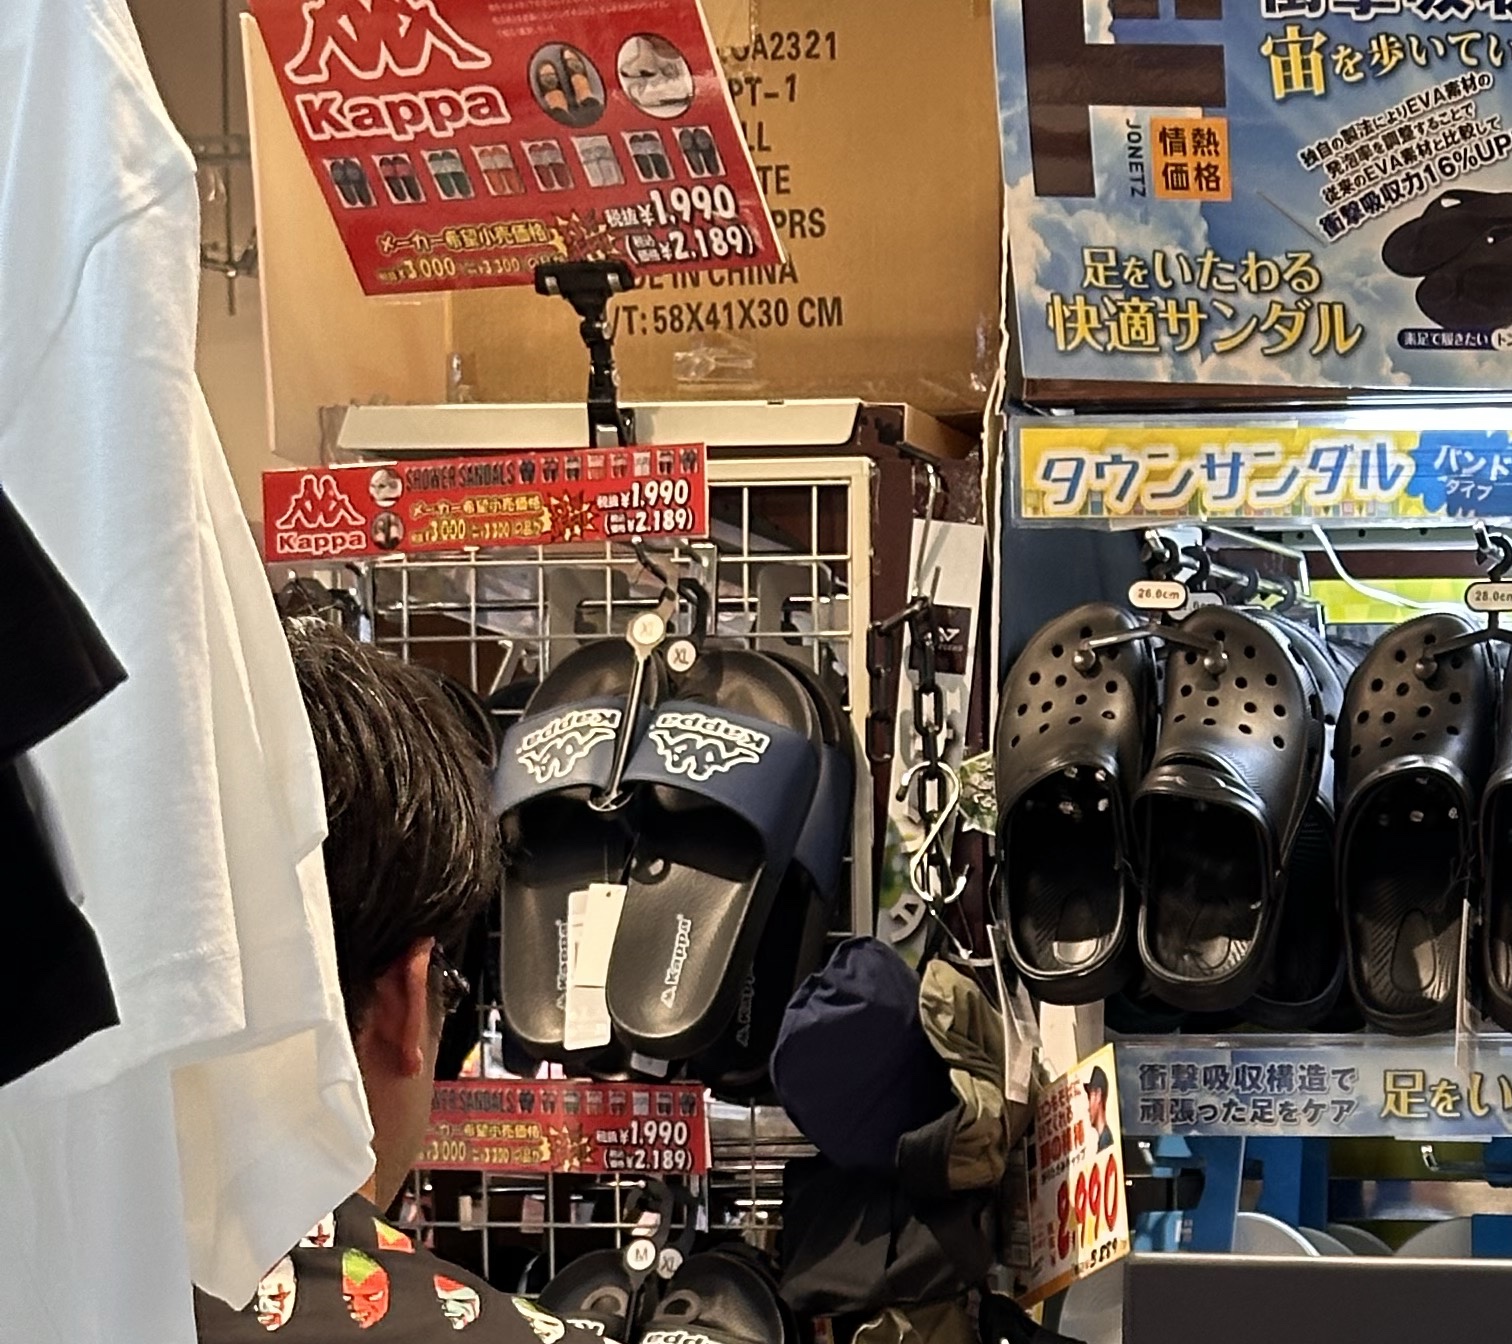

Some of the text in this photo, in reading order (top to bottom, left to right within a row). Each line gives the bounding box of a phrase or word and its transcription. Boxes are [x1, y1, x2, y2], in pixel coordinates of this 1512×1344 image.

[295, 84, 512, 141] Kappa
[1126, 118, 1147, 199] JONETZ
[1158, 125, 1221, 158] 情熱
[1161, 161, 1223, 193] 価格
[1081, 246, 1322, 294] 足をいたわる
[653, 298, 789, 335] 58X41X30
[796, 296, 843, 328] CM
[1046, 294, 1364, 357] 快適サンダル
[405, 457, 516, 492] SHOWER SANDALS
[1040, 441, 1407, 504] タウンサンダル
[1433, 444, 1511, 478] バンド
[1444, 478, 1496, 502] タイプ
[276, 531, 367, 555] Kappa
[655, 711, 771, 755] Kappa
[664, 916, 692, 988] Kappa
[1138, 1061, 1359, 1096] 衝撃吸収構造で
[1138, 1097, 1359, 1127] 頑張った足をケア
[635, 1247, 648, 1260] M
